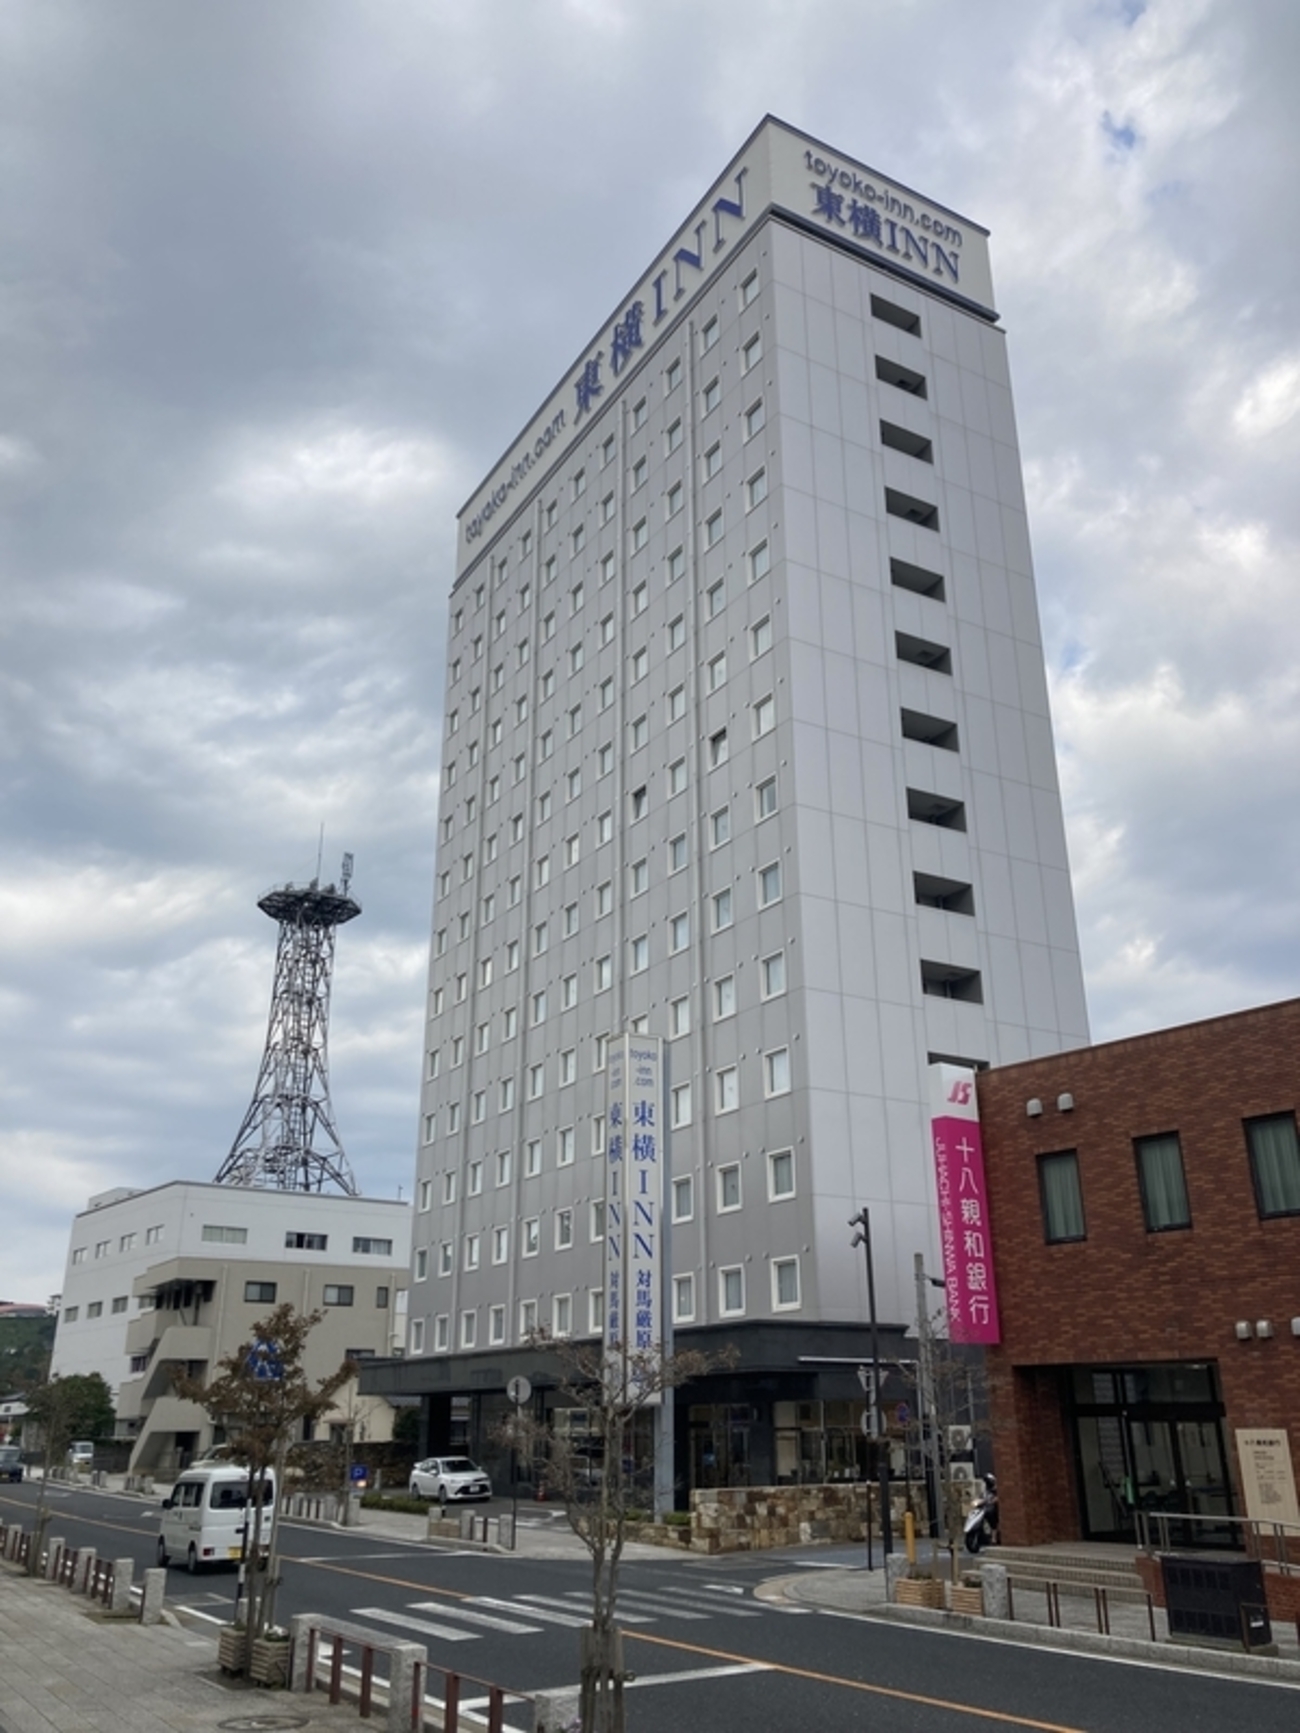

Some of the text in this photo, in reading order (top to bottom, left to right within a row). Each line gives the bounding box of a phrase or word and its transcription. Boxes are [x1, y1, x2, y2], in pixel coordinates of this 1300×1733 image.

[803, 149, 963, 248] toyoko-inn.com
[809, 181, 960, 285] 東横INN
[573, 166, 748, 426] 東横INN
[955, 1136, 990, 1325] 十八親和銀行
